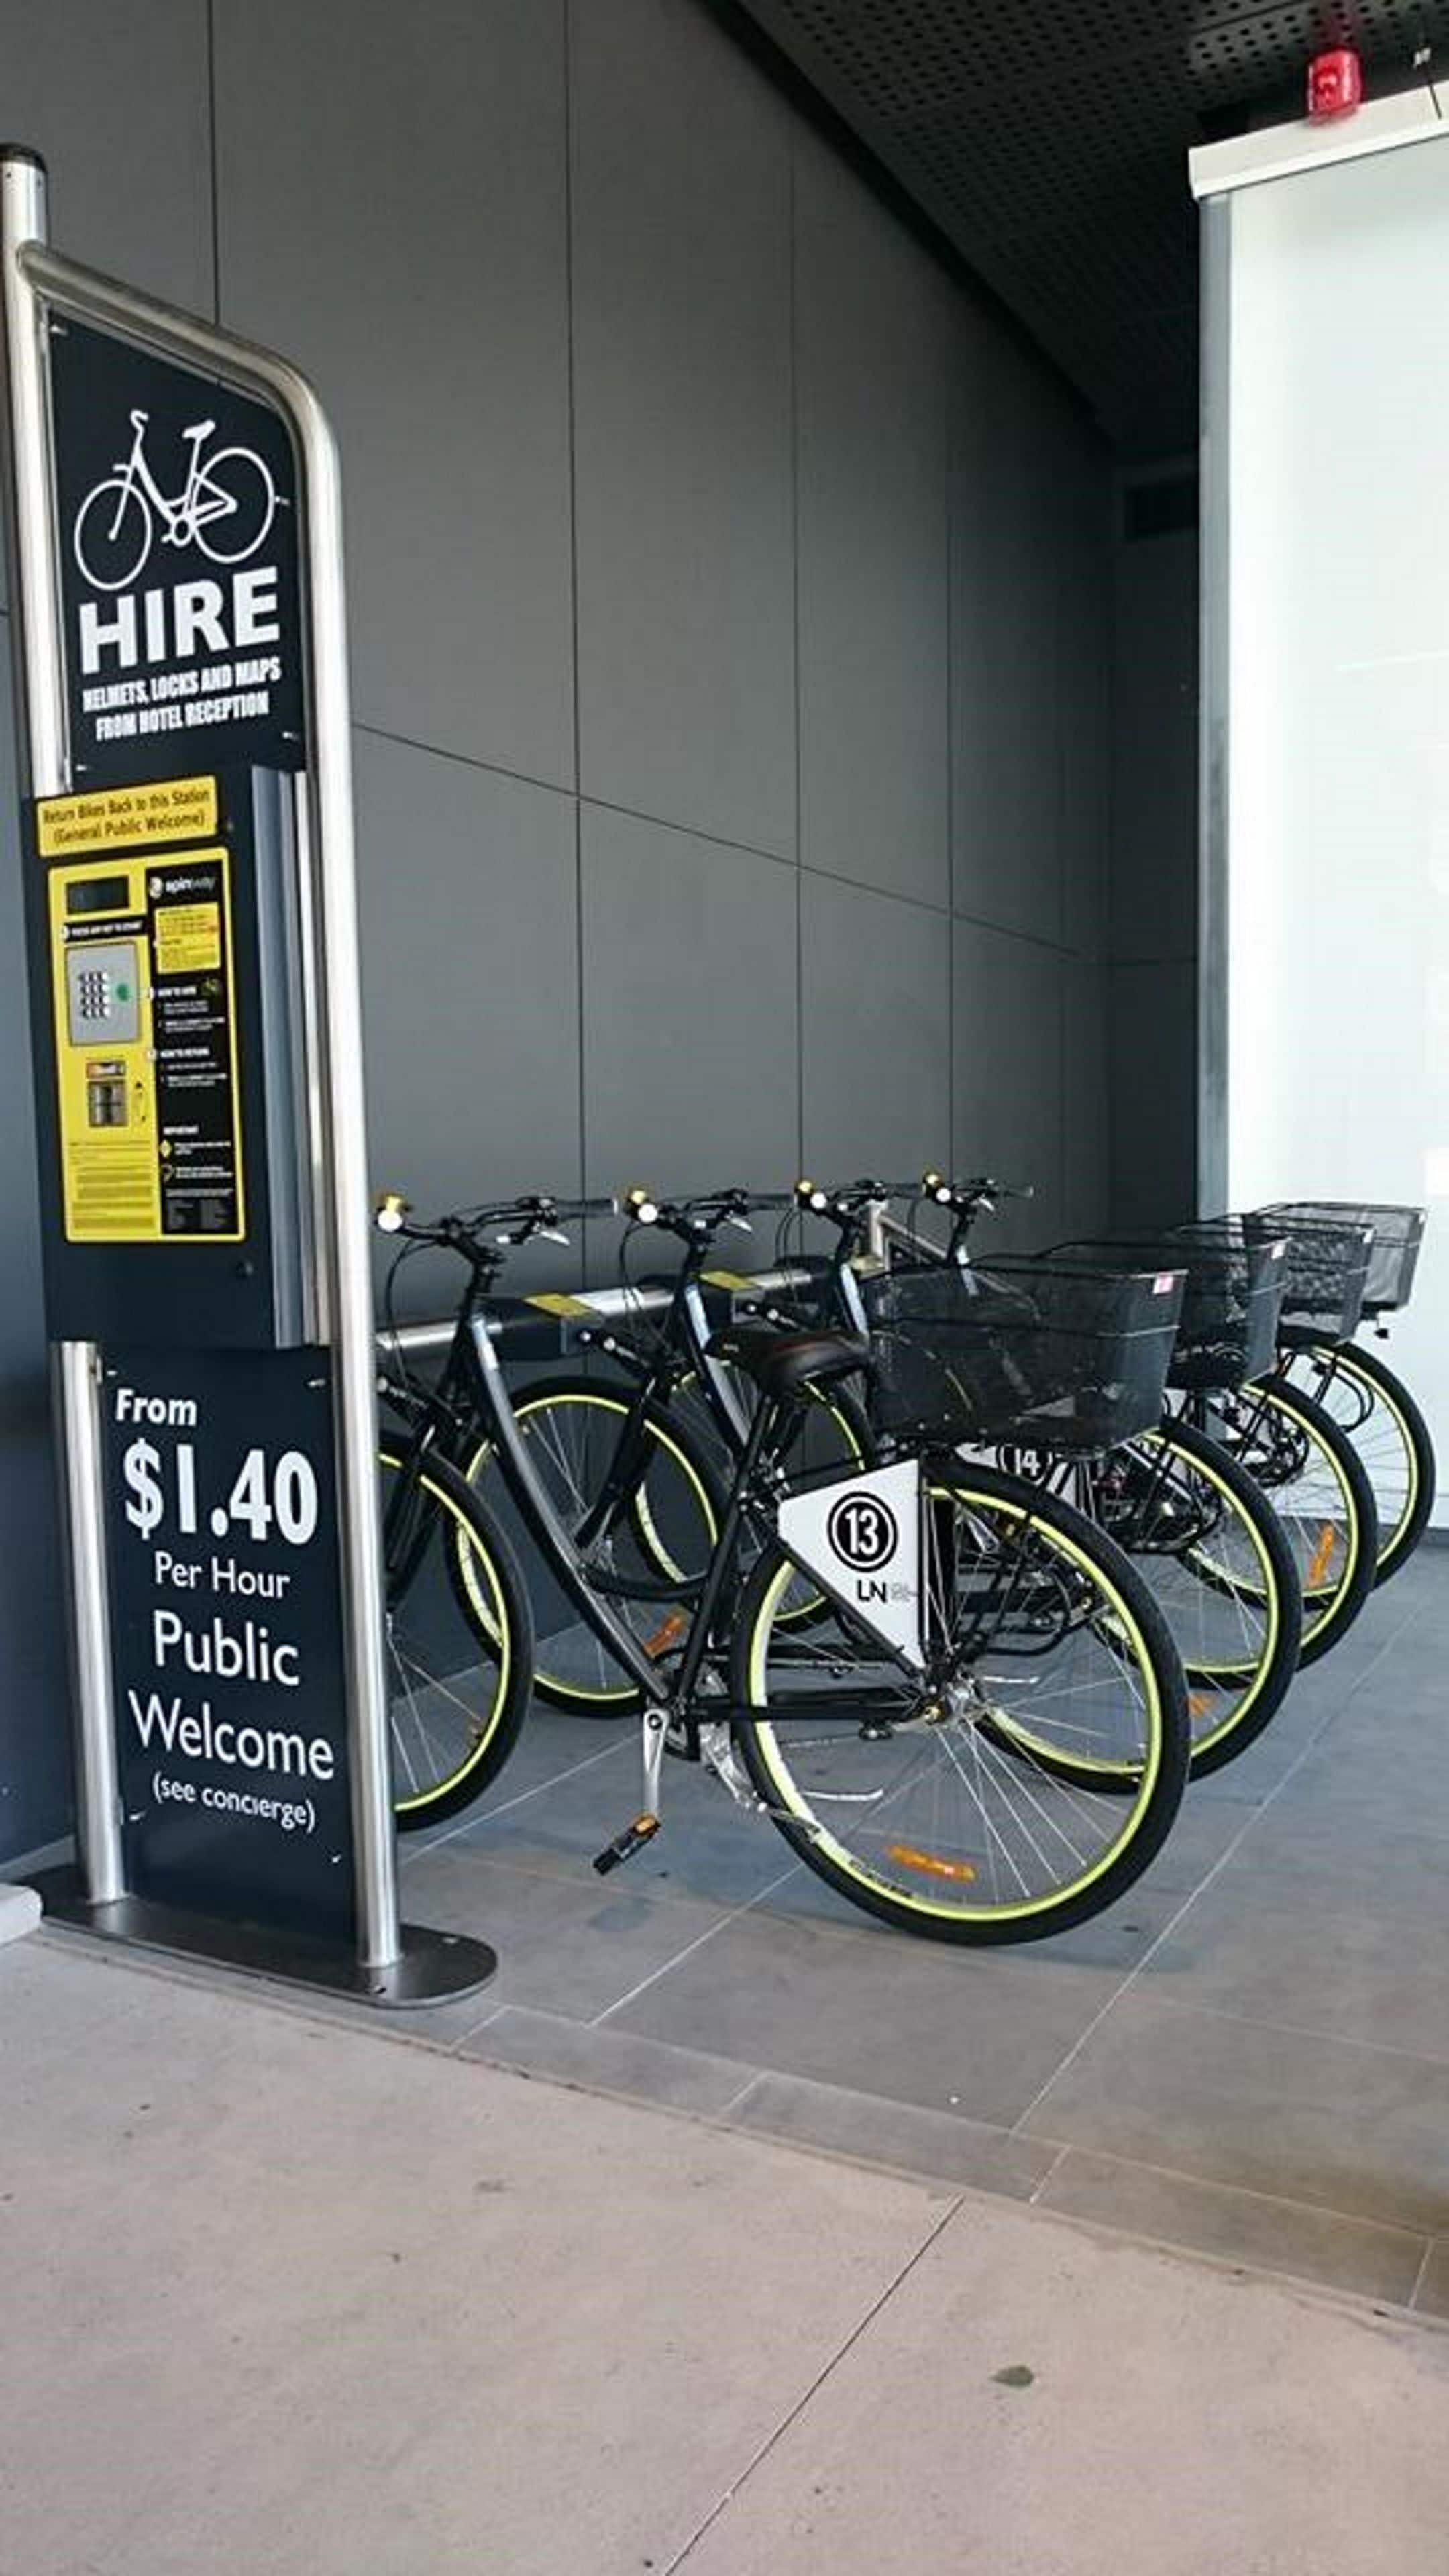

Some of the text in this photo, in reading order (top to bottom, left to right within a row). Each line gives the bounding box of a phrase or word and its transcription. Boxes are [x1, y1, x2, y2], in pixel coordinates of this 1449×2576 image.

[79, 566, 280, 675] HIRE
[150, 670, 199, 701] LOCKS
[201, 664, 233, 693] AND
[235, 656, 282, 687] MAPS
[95, 690, 269, 741] FROM HOTEL RECEPTION
[43, 788, 210, 824] Return Bikes Back to this Station
[54, 808, 205, 845] (General Public Welcome)
[115, 1388, 197, 1426] From
[1014, 1448, 1041, 1477] 14
[123, 1437, 318, 1544] $1.40
[845, 1508, 879, 1555] 13
[155, 1550, 291, 1599] Per Hour
[857, 1579, 887, 1603] LN
[154, 1609, 300, 1686] Public
[128, 1689, 335, 1780] Welcome
[152, 1771, 316, 1833] (see concierge)
